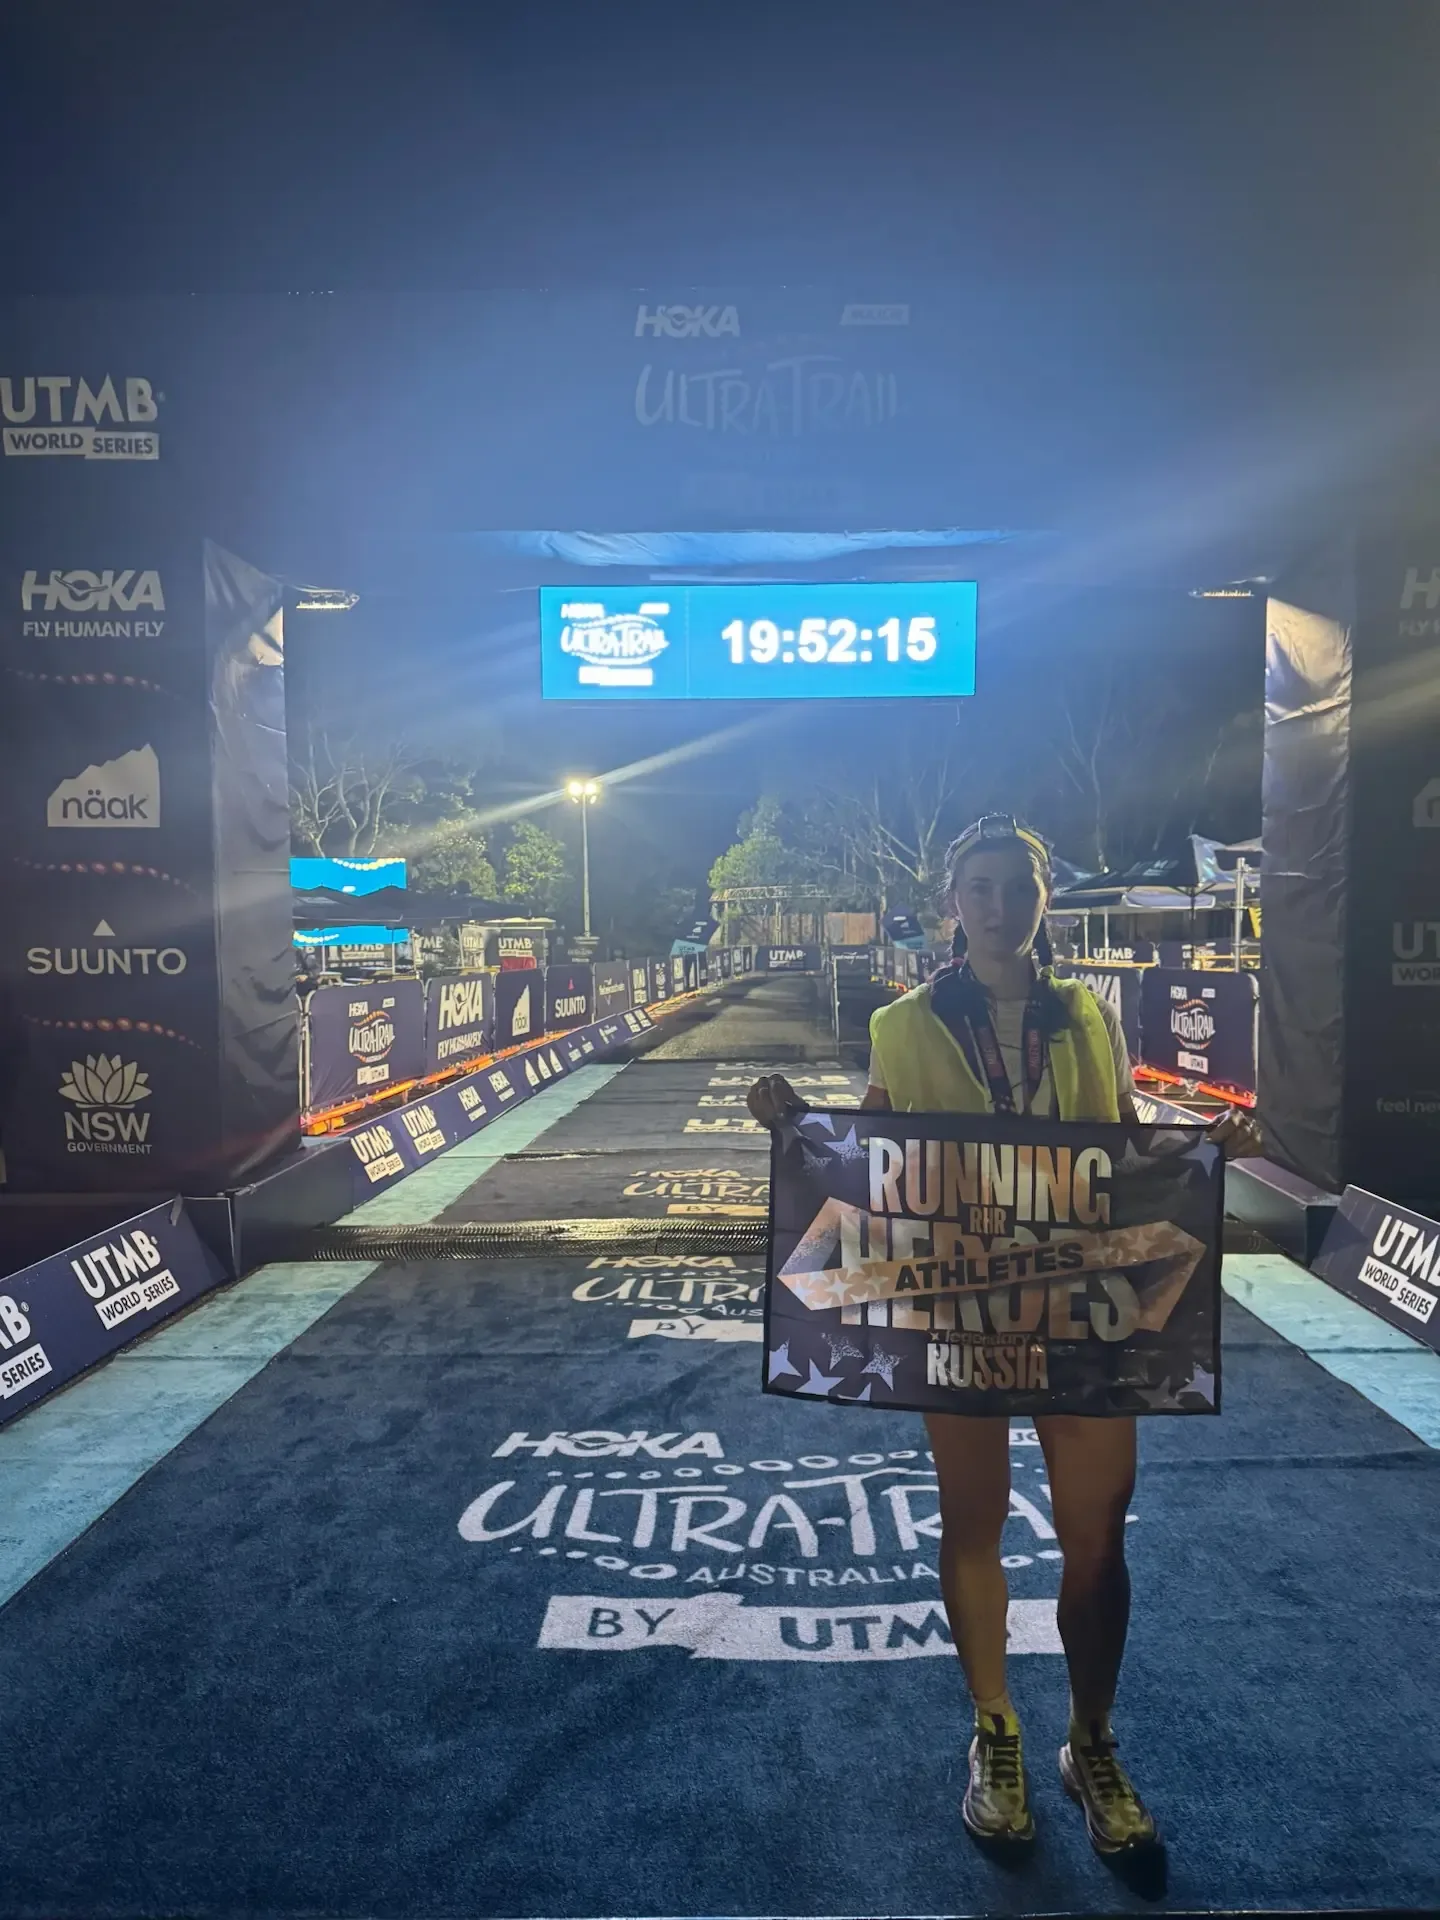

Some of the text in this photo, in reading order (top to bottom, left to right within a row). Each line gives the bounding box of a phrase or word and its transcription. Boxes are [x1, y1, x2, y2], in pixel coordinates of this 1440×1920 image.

[634, 304, 741, 338] HOKA
[0, 373, 158, 425] UTMB
[10, 433, 153, 455] WORLD SERIES
[21, 569, 165, 612] HOKA
[23, 620, 165, 638] FLY HUMAN FLY
[720, 616, 938, 665] 19:52:15
[62, 789, 149, 821] näak
[497, 937, 532, 950] UTMB
[1093, 947, 1134, 961] UTMB
[27, 946, 188, 976] SUUNTO
[438, 979, 484, 1031] HOKA
[554, 994, 587, 1019] SUUNTO
[63, 1111, 151, 1142] NSW
[401, 1104, 438, 1138] UTMB
[67, 1141, 153, 1154] GOVERNMENT
[350, 1124, 395, 1164] UTMB
[867, 1136, 1113, 1226] RUNNING
[969, 1205, 1007, 1235] RHR
[70, 1229, 162, 1300] UTMB
[585, 1255, 737, 1269] HOKA
[894, 1242, 1085, 1293] ATHLETES
[143, 1274, 175, 1304] SERIES
[1364, 1262, 1432, 1316] WORLD SERIES
[100, 1290, 142, 1323] WORLD
[1, 1351, 46, 1389] SERIES
[926, 1342, 1050, 1391] RUSSIA
[491, 1430, 725, 1459] HOKA
[684, 1561, 941, 1588] AUSTRALIA
[587, 1606, 678, 1639] BY
